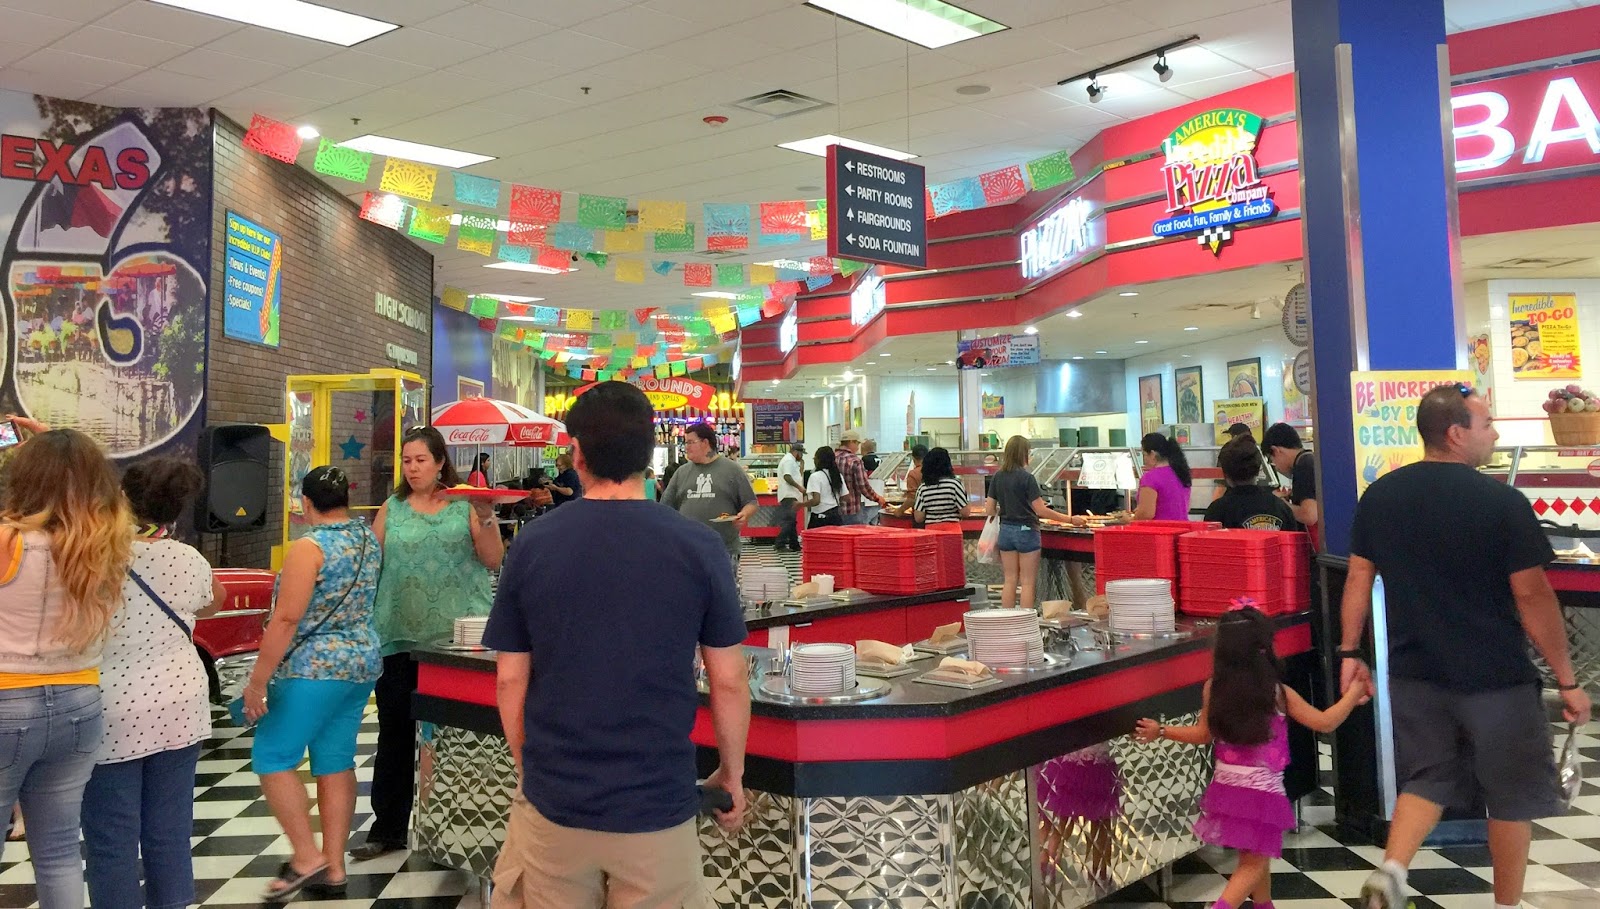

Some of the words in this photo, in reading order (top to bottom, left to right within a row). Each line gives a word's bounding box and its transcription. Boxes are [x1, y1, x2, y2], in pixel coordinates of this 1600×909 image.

[1175, 111, 1246, 142] AMERICA'S
[857, 162, 905, 184] RESTROOMS
[1160, 153, 1262, 213] Pizza
[857, 186, 882, 202] PARTY
[884, 192, 912, 209] ROOMS
[229, 217, 240, 231] Sign
[246, 227, 257, 238] here
[858, 210, 911, 232] FAIRGROUNDS
[1154, 222, 1173, 234] Great
[1174, 217, 1192, 229] Food,
[1194, 215, 1208, 226] Fun,
[1209, 209, 1232, 222] Family
[1234, 207, 1242, 218] &
[1243, 202, 1271, 217] Friends
[858, 235, 880, 250] SODA
[883, 240, 919, 256] FOUNTAIN
[374, 292, 398, 320] HIGH
[398, 303, 427, 333] SCHOOL
[1512, 294, 1554, 314] Incredible
[1528, 307, 1574, 325] TO-GO
[634, 379, 703, 398] ROUNDS
[1356, 381, 1376, 414] BE
[1381, 406, 1402, 421] BY
[449, 428, 490, 442] Coca-Cola
[520, 426, 542, 439] Coca-Cola
[1358, 426, 1418, 446] GERM
